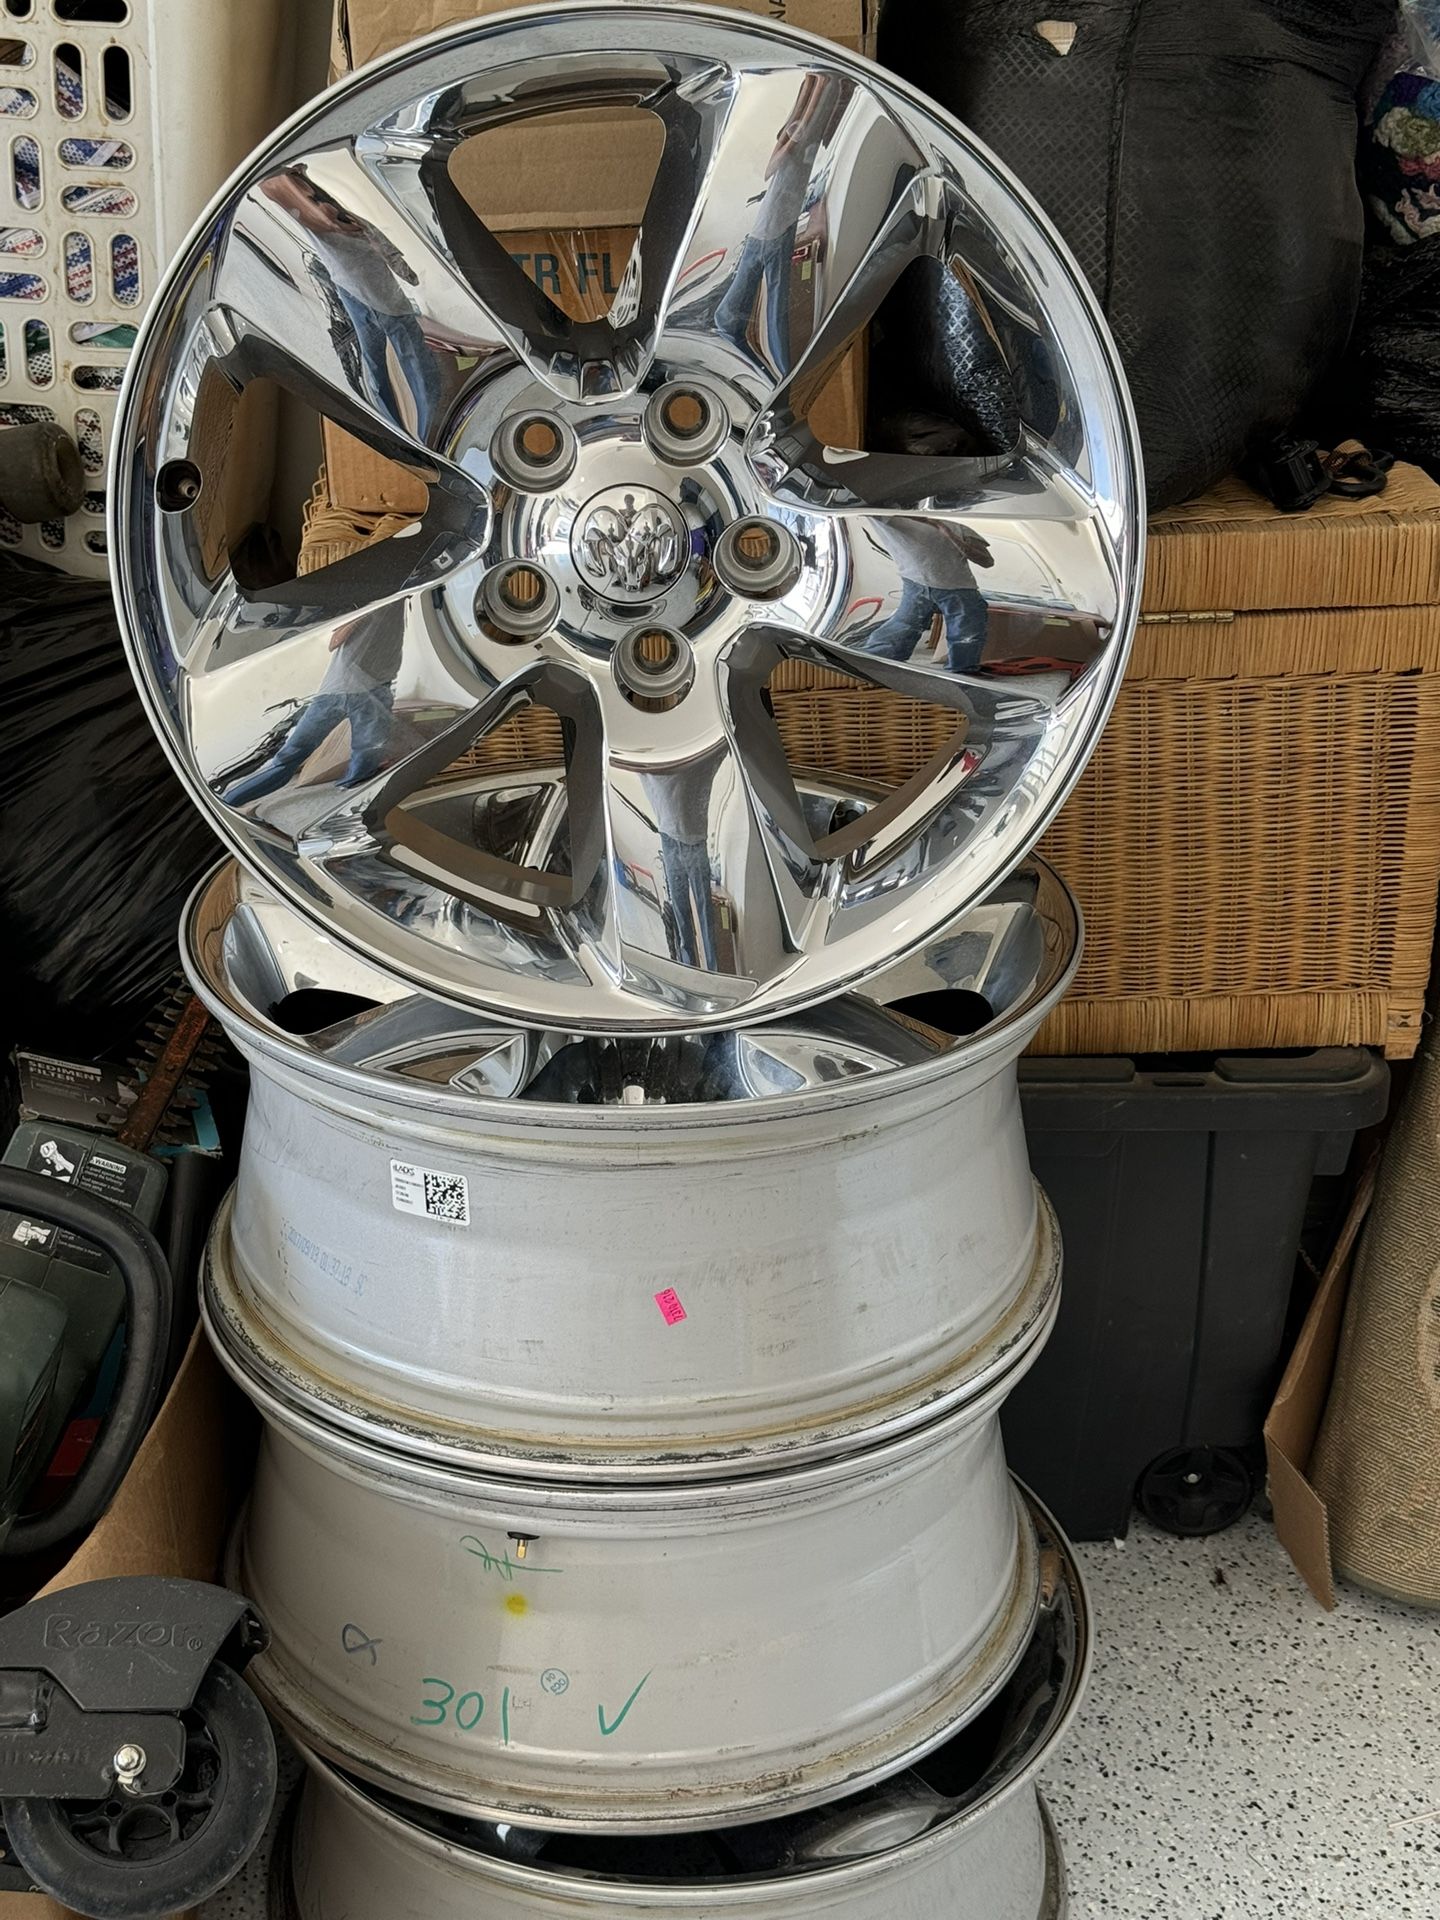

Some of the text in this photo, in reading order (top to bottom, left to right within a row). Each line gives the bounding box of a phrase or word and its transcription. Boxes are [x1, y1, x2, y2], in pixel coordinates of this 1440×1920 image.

[28, 1060, 103, 1083] SEDIMENT
[29, 1067, 76, 1082] FILTER
[95, 1158, 125, 1173] WARNING
[43, 1612, 202, 1649] Razor
[409, 1677, 511, 1746] 301
